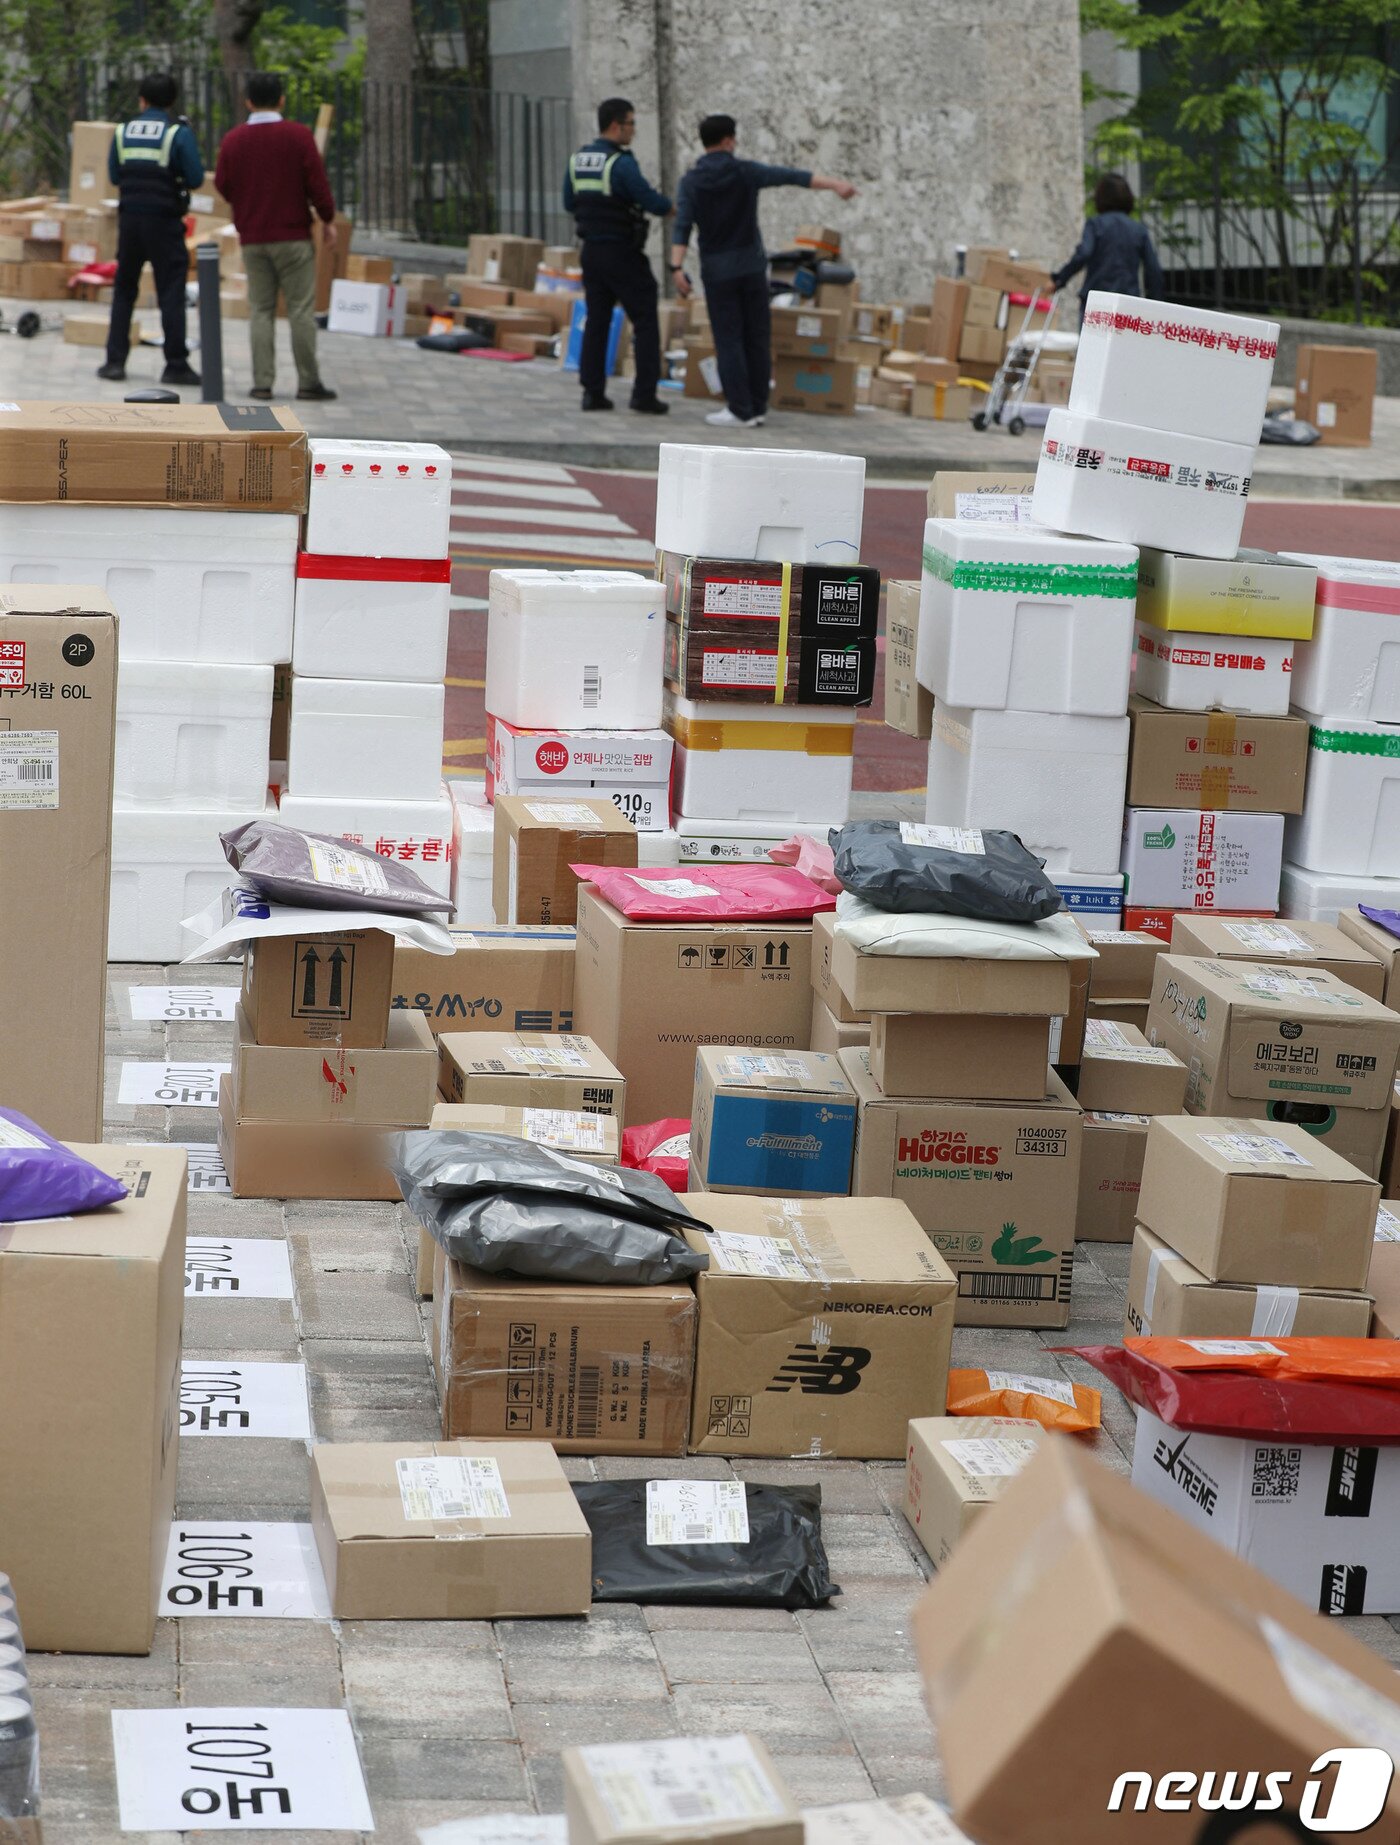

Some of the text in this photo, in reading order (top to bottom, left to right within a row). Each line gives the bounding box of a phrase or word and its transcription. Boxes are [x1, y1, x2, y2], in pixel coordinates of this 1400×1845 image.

[58, 437, 69, 500] SSAPER
[821, 585, 859, 601] 올바른
[821, 602, 858, 614] 세척사과
[69, 643, 87, 656] 2P
[819, 653, 857, 669] 올바른
[1173, 650, 1210, 666] 취급주의
[1213, 653, 1266, 671] 당일배송
[819, 670, 856, 682] 세척사과
[0, 682, 92, 699] 거함 60L
[539, 750, 566, 767] 햇반
[573, 752, 653, 766] 언제나 맛있는 집밥
[612, 793, 652, 813] 210g
[1194, 871, 1215, 907] 당일
[541, 896, 551, 925] 856-47
[1142, 917, 1164, 928] Jeju
[164, 989, 223, 1019] 101동
[1282, 1025, 1300, 1033] DONG
[657, 1033, 795, 1046] www.saengong.com
[1256, 1042, 1319, 1064] 에코보리
[1343, 1070, 1366, 1078] 취급주의
[154, 1067, 219, 1102] 102동
[583, 1087, 614, 1104] 택배
[920, 1129, 968, 1143] 하기스
[1017, 1128, 1067, 1139] 11040057
[745, 1136, 823, 1152] e-Fulfillment
[898, 1137, 1000, 1165] HUGGIES
[1023, 1141, 1059, 1153] 34313
[788, 1151, 796, 1159] CJ
[896, 1167, 972, 1180] 네이처메이드
[973, 1170, 993, 1180] 팬티
[184, 1244, 240, 1292] 104동
[823, 1301, 933, 1317] NBKOREA.COM
[549, 1332, 557, 1348] PCS
[549, 1351, 556, 1361] 12
[643, 1340, 651, 1368] KOREA
[566, 1326, 580, 1439] (HONEYSUCKLE&GALBANUM)
[643, 1368, 649, 1381] TO
[180, 1370, 249, 1431] 105동
[641, 1407, 647, 1417] IN
[1153, 1432, 1218, 1517] EXTREME
[167, 1531, 263, 1610] 106동
[181, 1722, 292, 1820] 107동
